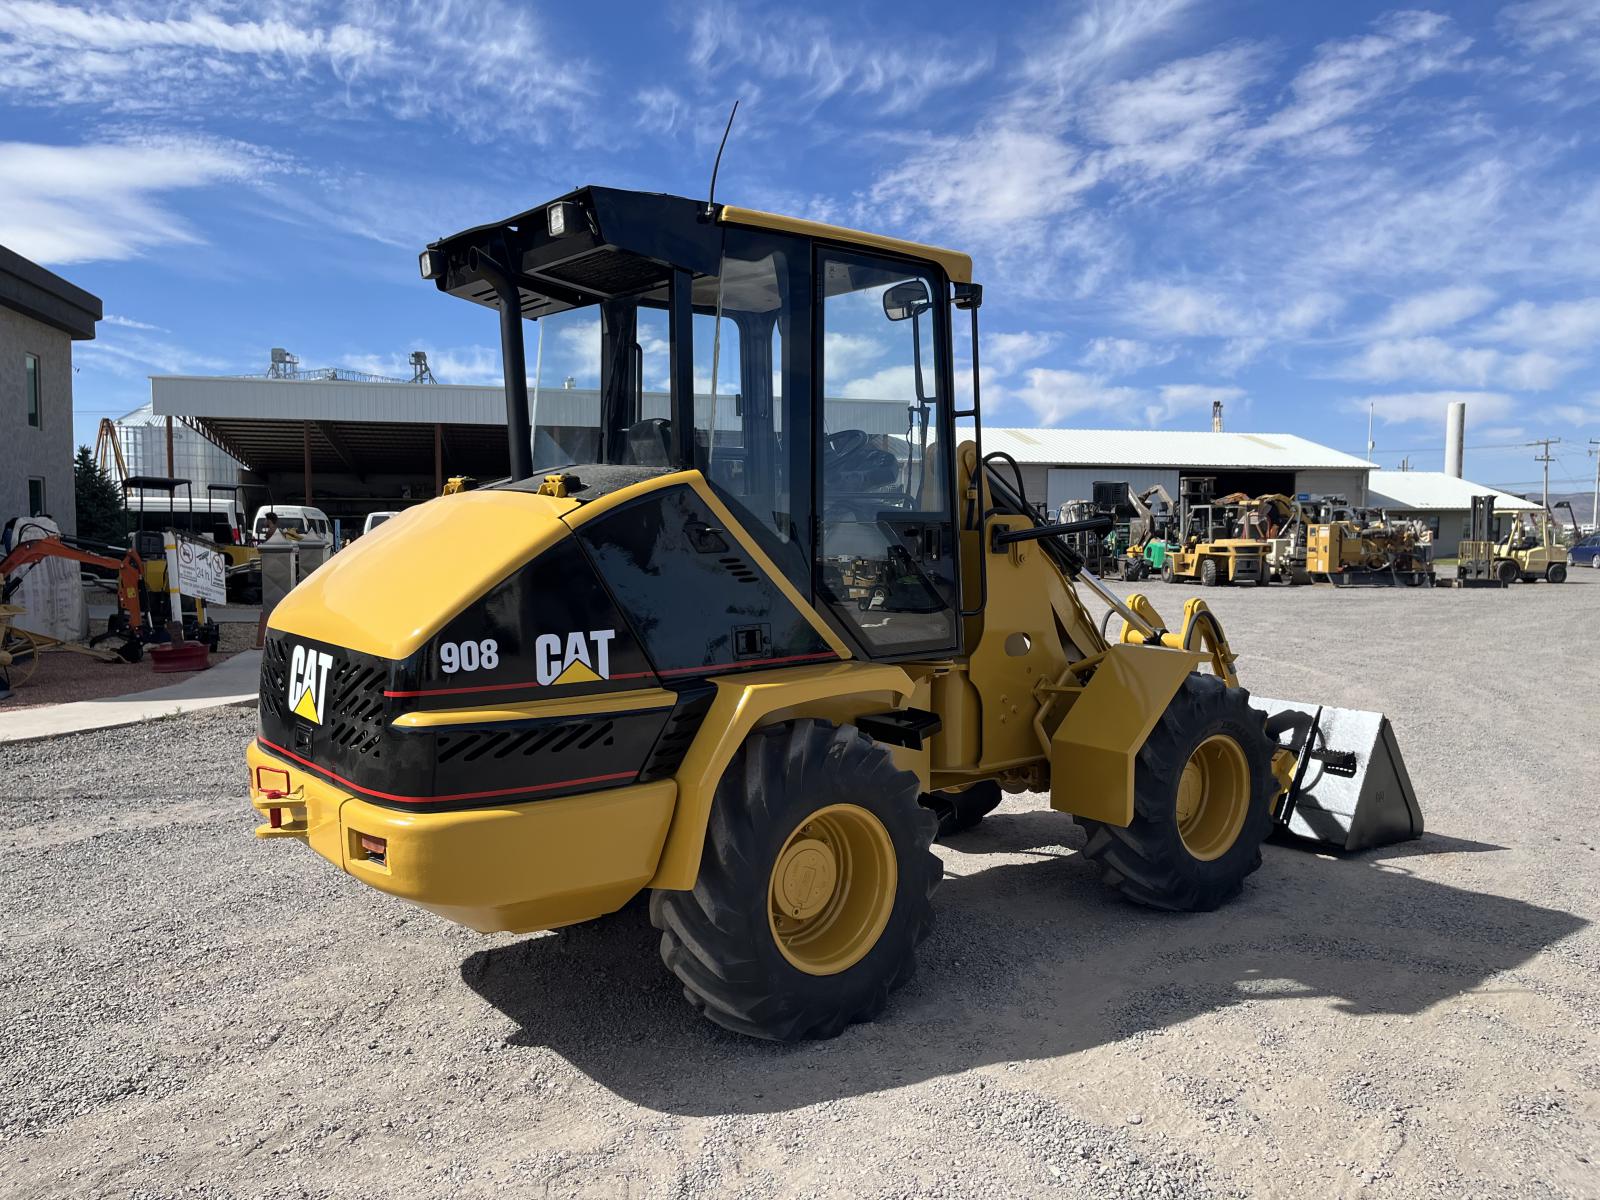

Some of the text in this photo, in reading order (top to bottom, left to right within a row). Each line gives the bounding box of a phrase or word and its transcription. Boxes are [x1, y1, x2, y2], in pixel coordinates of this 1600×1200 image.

[196, 567, 204, 578] 24
[440, 639, 499, 674] 908
[535, 629, 615, 686] CAT
[288, 645, 334, 725] CAT
